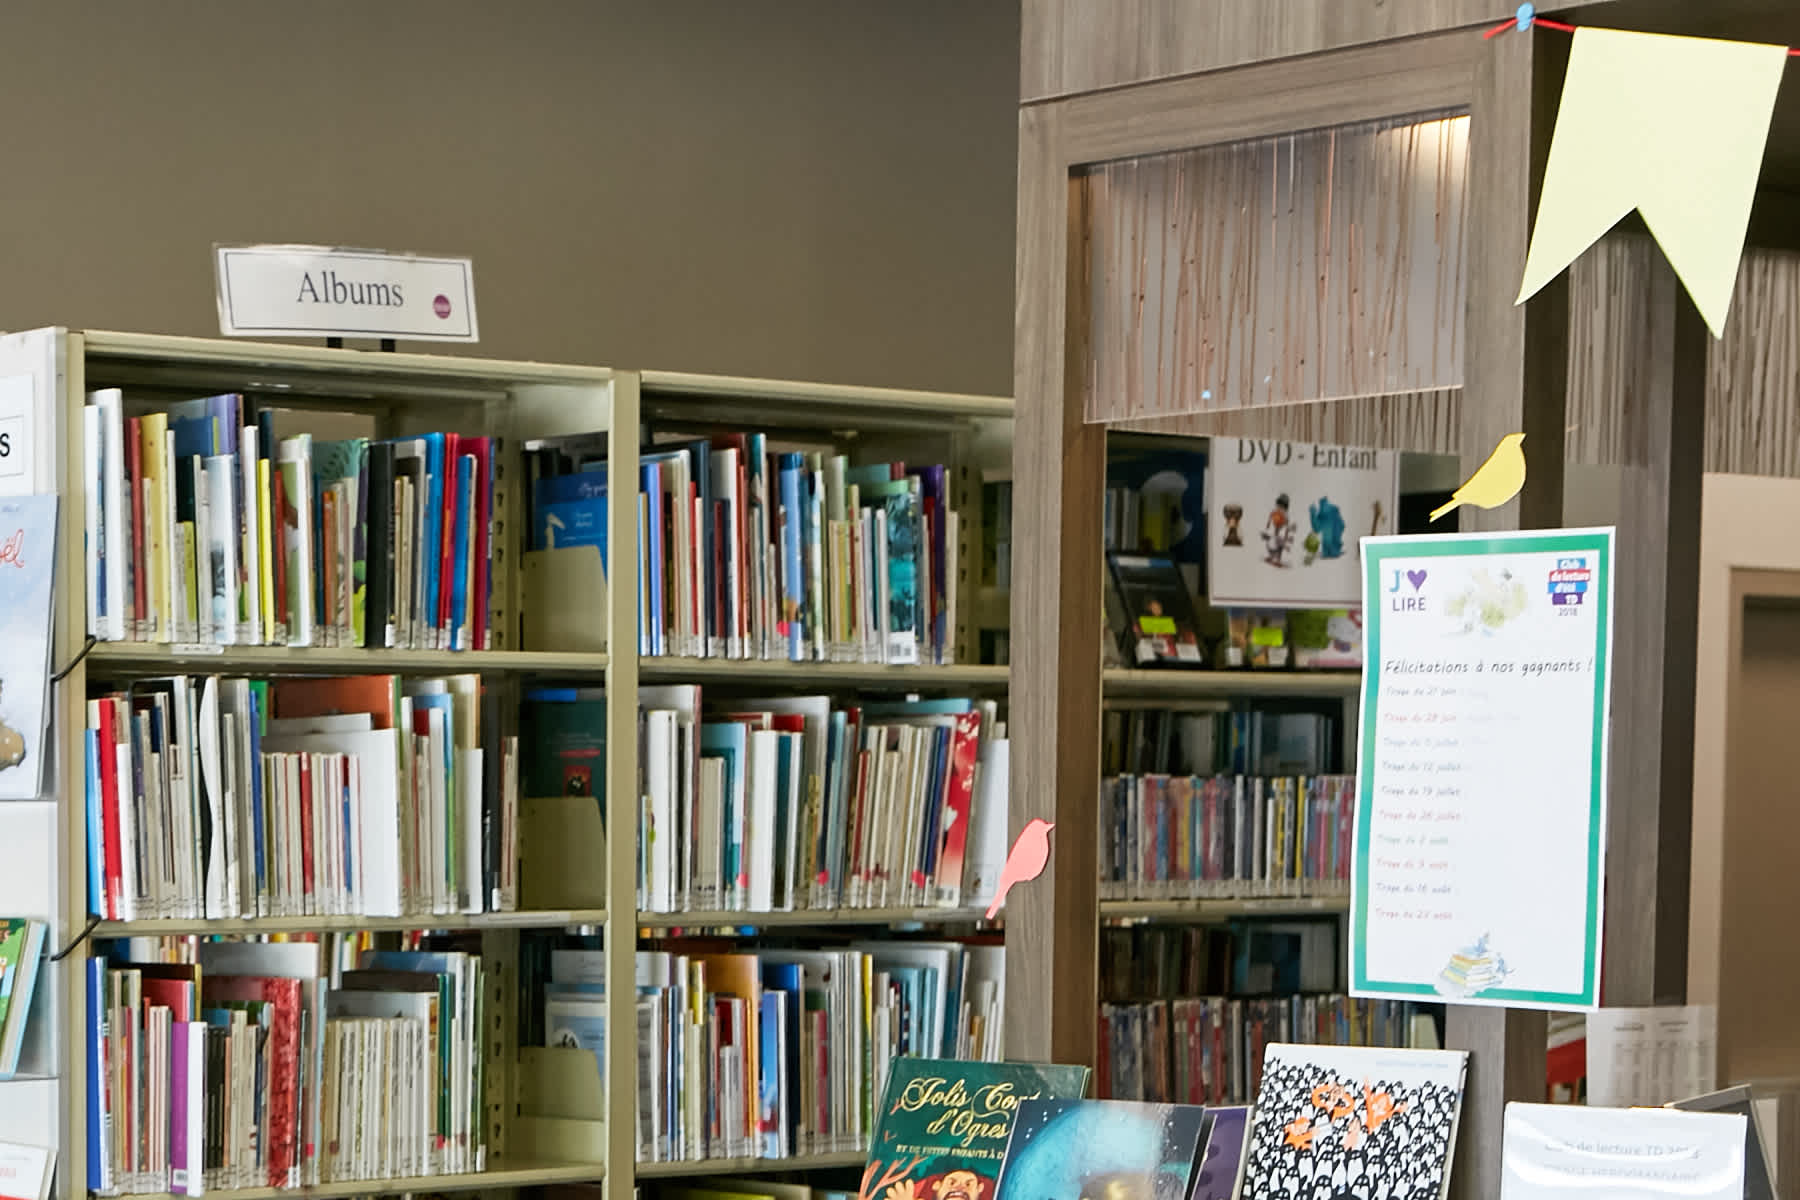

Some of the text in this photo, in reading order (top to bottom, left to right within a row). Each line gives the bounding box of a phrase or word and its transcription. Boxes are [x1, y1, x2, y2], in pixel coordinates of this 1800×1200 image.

[297, 270, 404, 309] Albums
[1238, 439, 1292, 465] DVD
[1392, 597, 1426, 612] LIRE
[1385, 659, 1468, 675] Félicitations
[1476, 661, 1483, 673] à
[1491, 662, 1514, 673] nos
[1521, 661, 1581, 676] gagnants
[901, 1078, 971, 1112] Jolis
[927, 1109, 1010, 1147] d'Ogres
